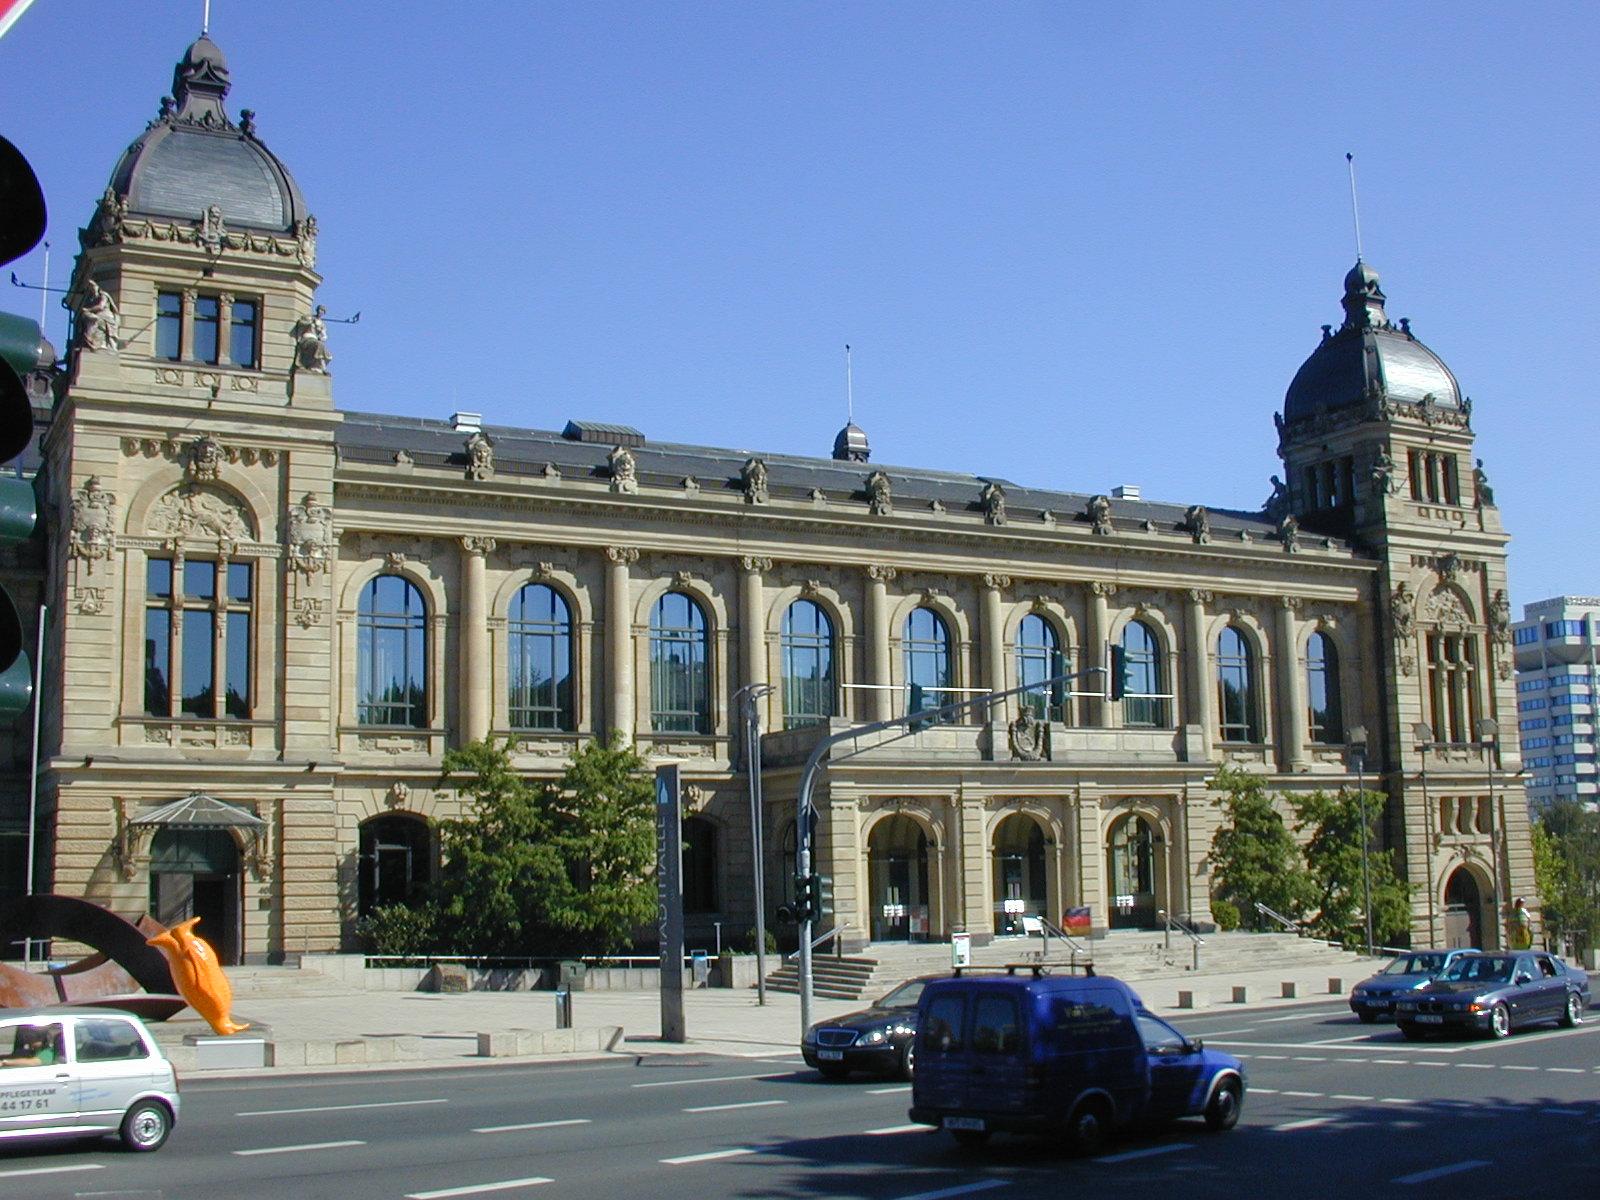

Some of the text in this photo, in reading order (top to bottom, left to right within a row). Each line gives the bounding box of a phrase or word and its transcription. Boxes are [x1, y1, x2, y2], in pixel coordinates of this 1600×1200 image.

[658, 816, 668, 963] STADTHALLE
[20, 1100, 32, 1109] 17
[36, 1099, 49, 1109] 61
